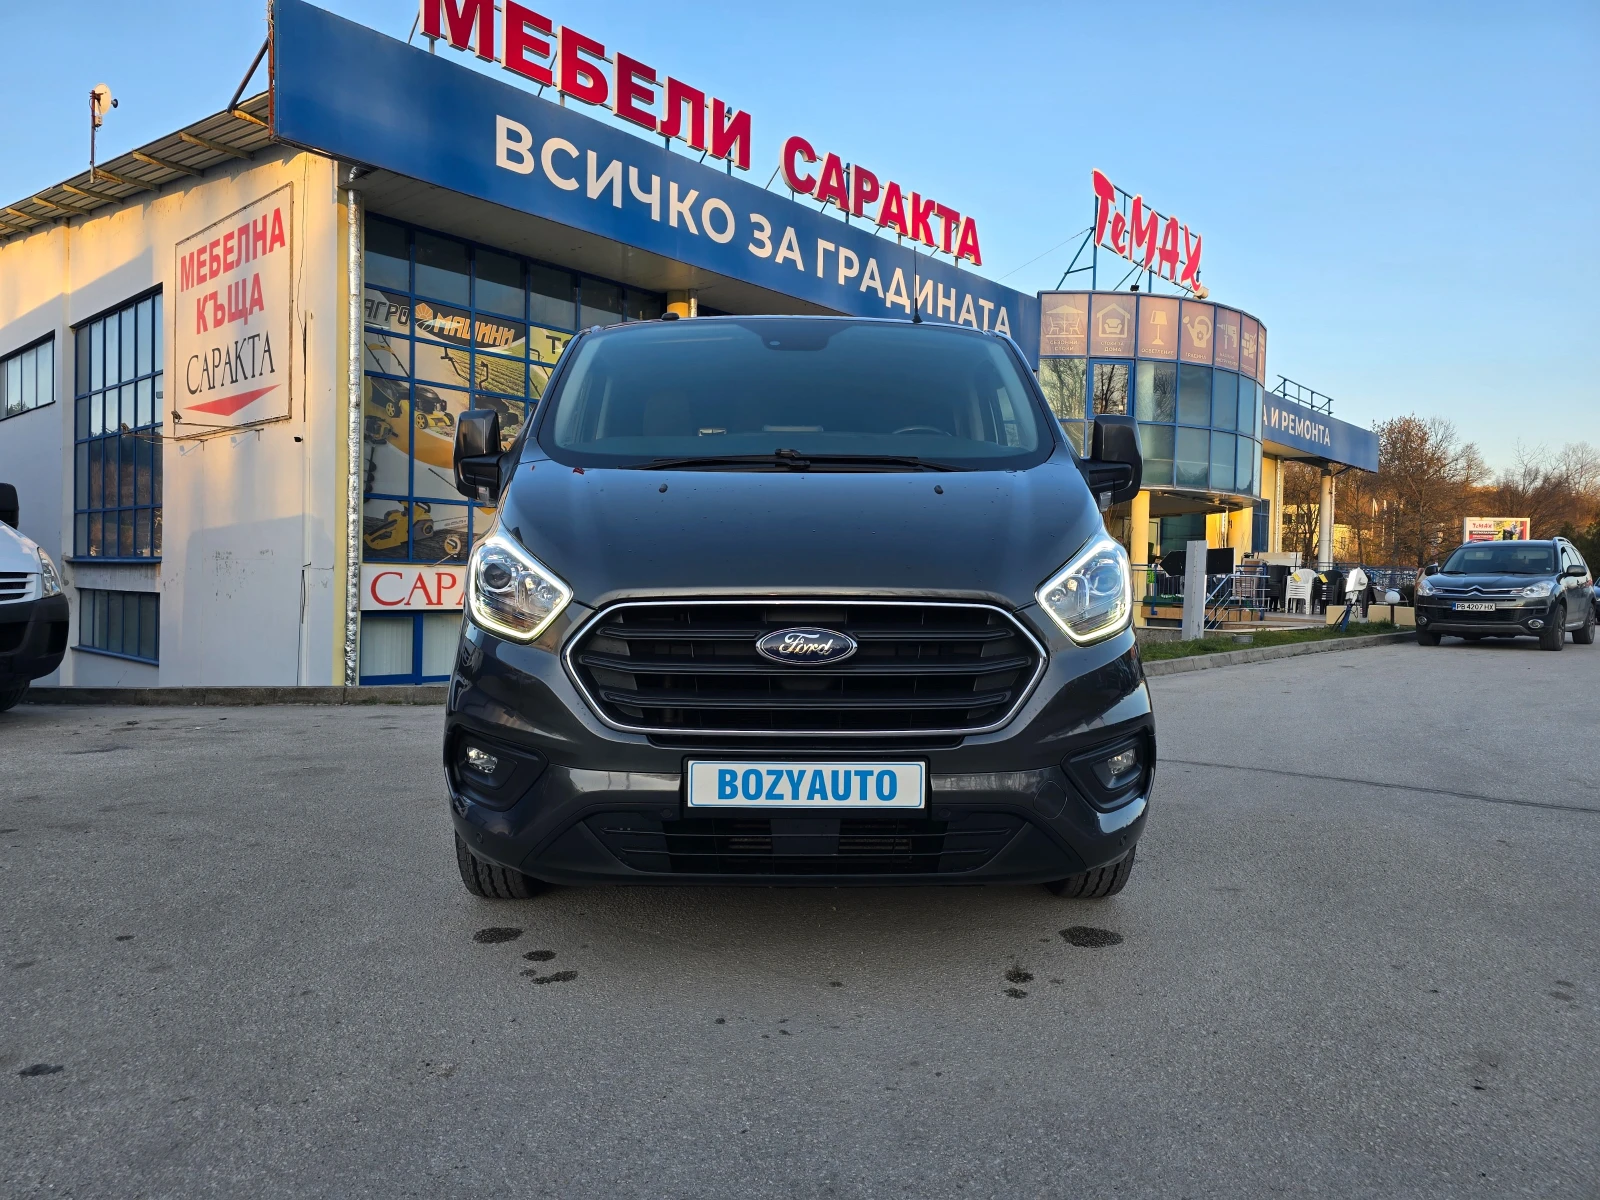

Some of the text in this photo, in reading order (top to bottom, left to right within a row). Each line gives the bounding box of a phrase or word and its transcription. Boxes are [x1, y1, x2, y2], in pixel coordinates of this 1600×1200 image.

[419, 0, 983, 266] МЕБЕЛИ САРАКТА
[180, 206, 286, 293] МЕБЕЛНА
[495, 114, 1012, 337] ВСИЧКО ЗА ГРАДИНАТА
[196, 272, 265, 335] КЪЩА
[364, 298, 516, 349] АГРО МАШИНИ
[186, 329, 276, 396] САРАКТА
[1271, 407, 1279, 429] И
[1281, 410, 1331, 447] РЕМОНТА
[778, 632, 835, 656] Ford
[717, 768, 899, 802] BOZYAUTO
